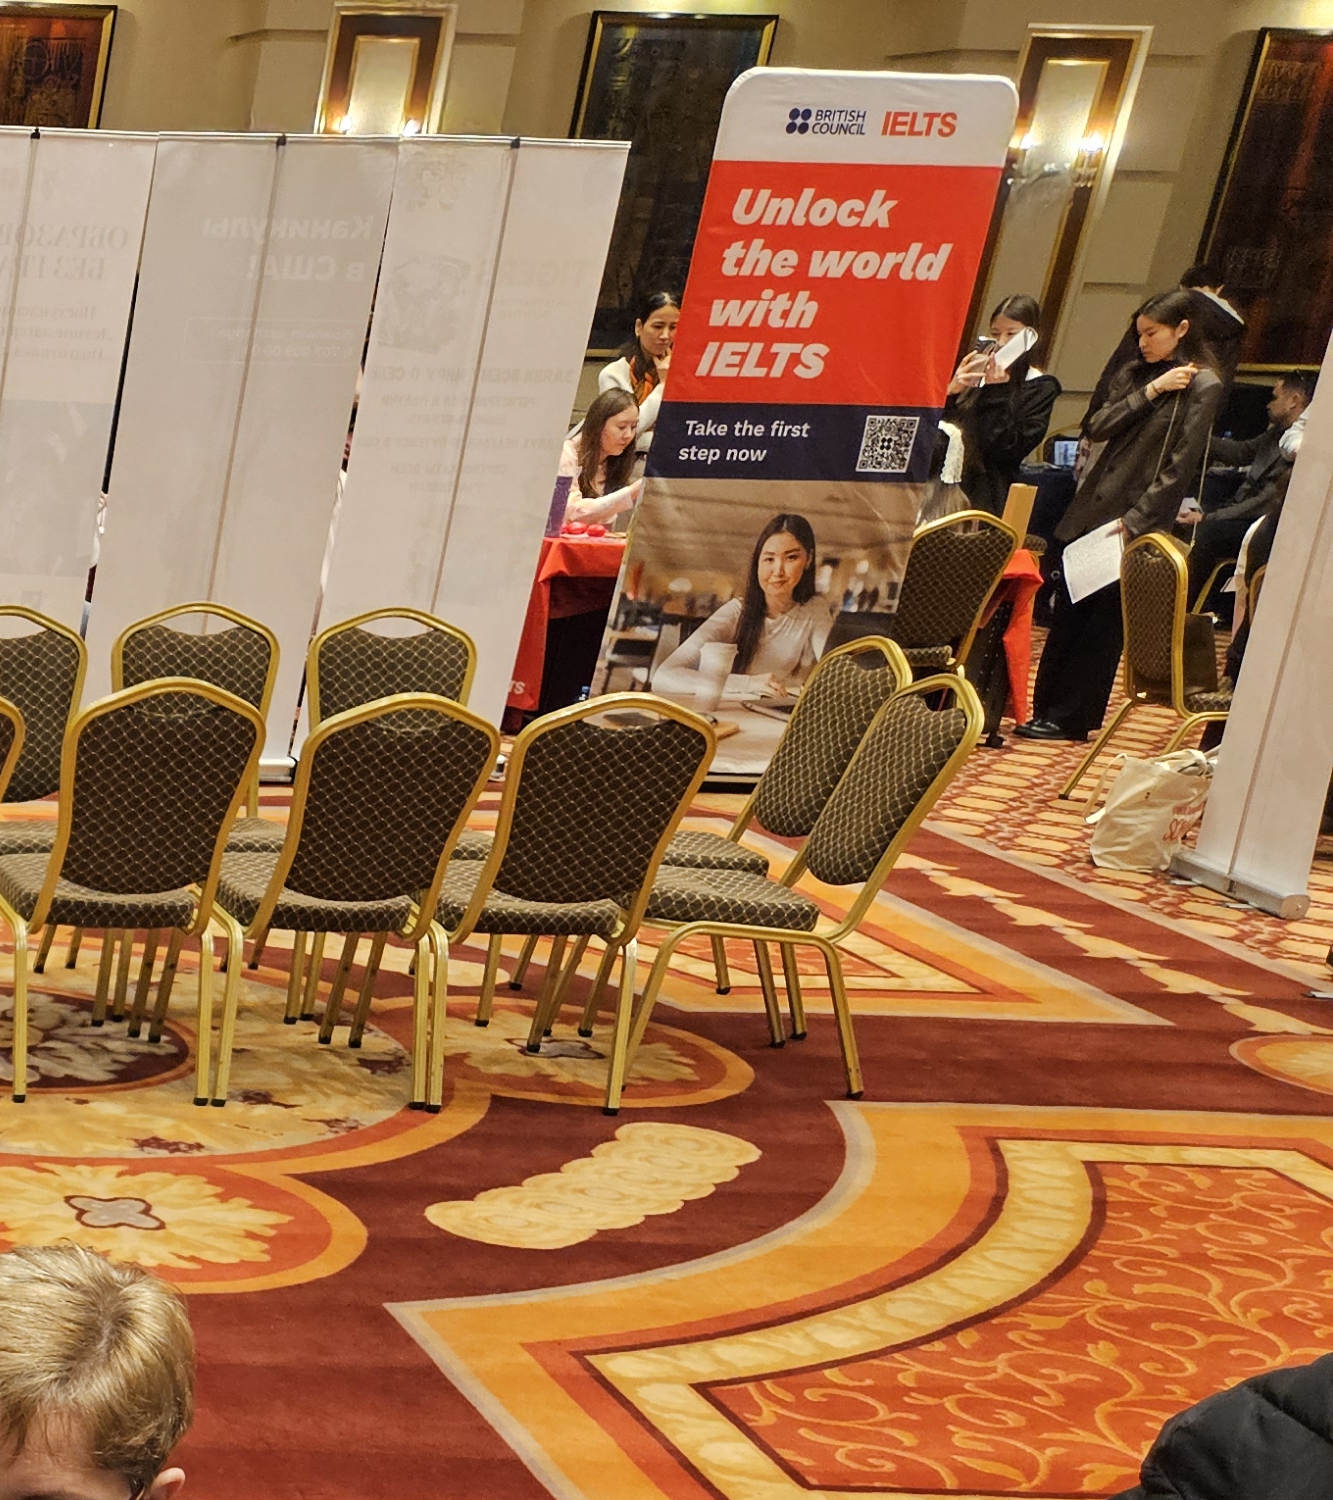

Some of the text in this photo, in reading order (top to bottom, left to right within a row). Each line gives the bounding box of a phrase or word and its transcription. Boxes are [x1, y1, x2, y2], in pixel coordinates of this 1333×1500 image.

[812, 122, 866, 135] COUNCIL
[815, 109, 867, 123] BRITISH
[881, 111, 958, 137] IELTS
[732, 187, 898, 228] Unlock
[721, 239, 954, 281] the world
[708, 289, 819, 329] with
[694, 342, 830, 379] IELTS
[685, 419, 811, 438] Take the first
[678, 445, 767, 465] step now
